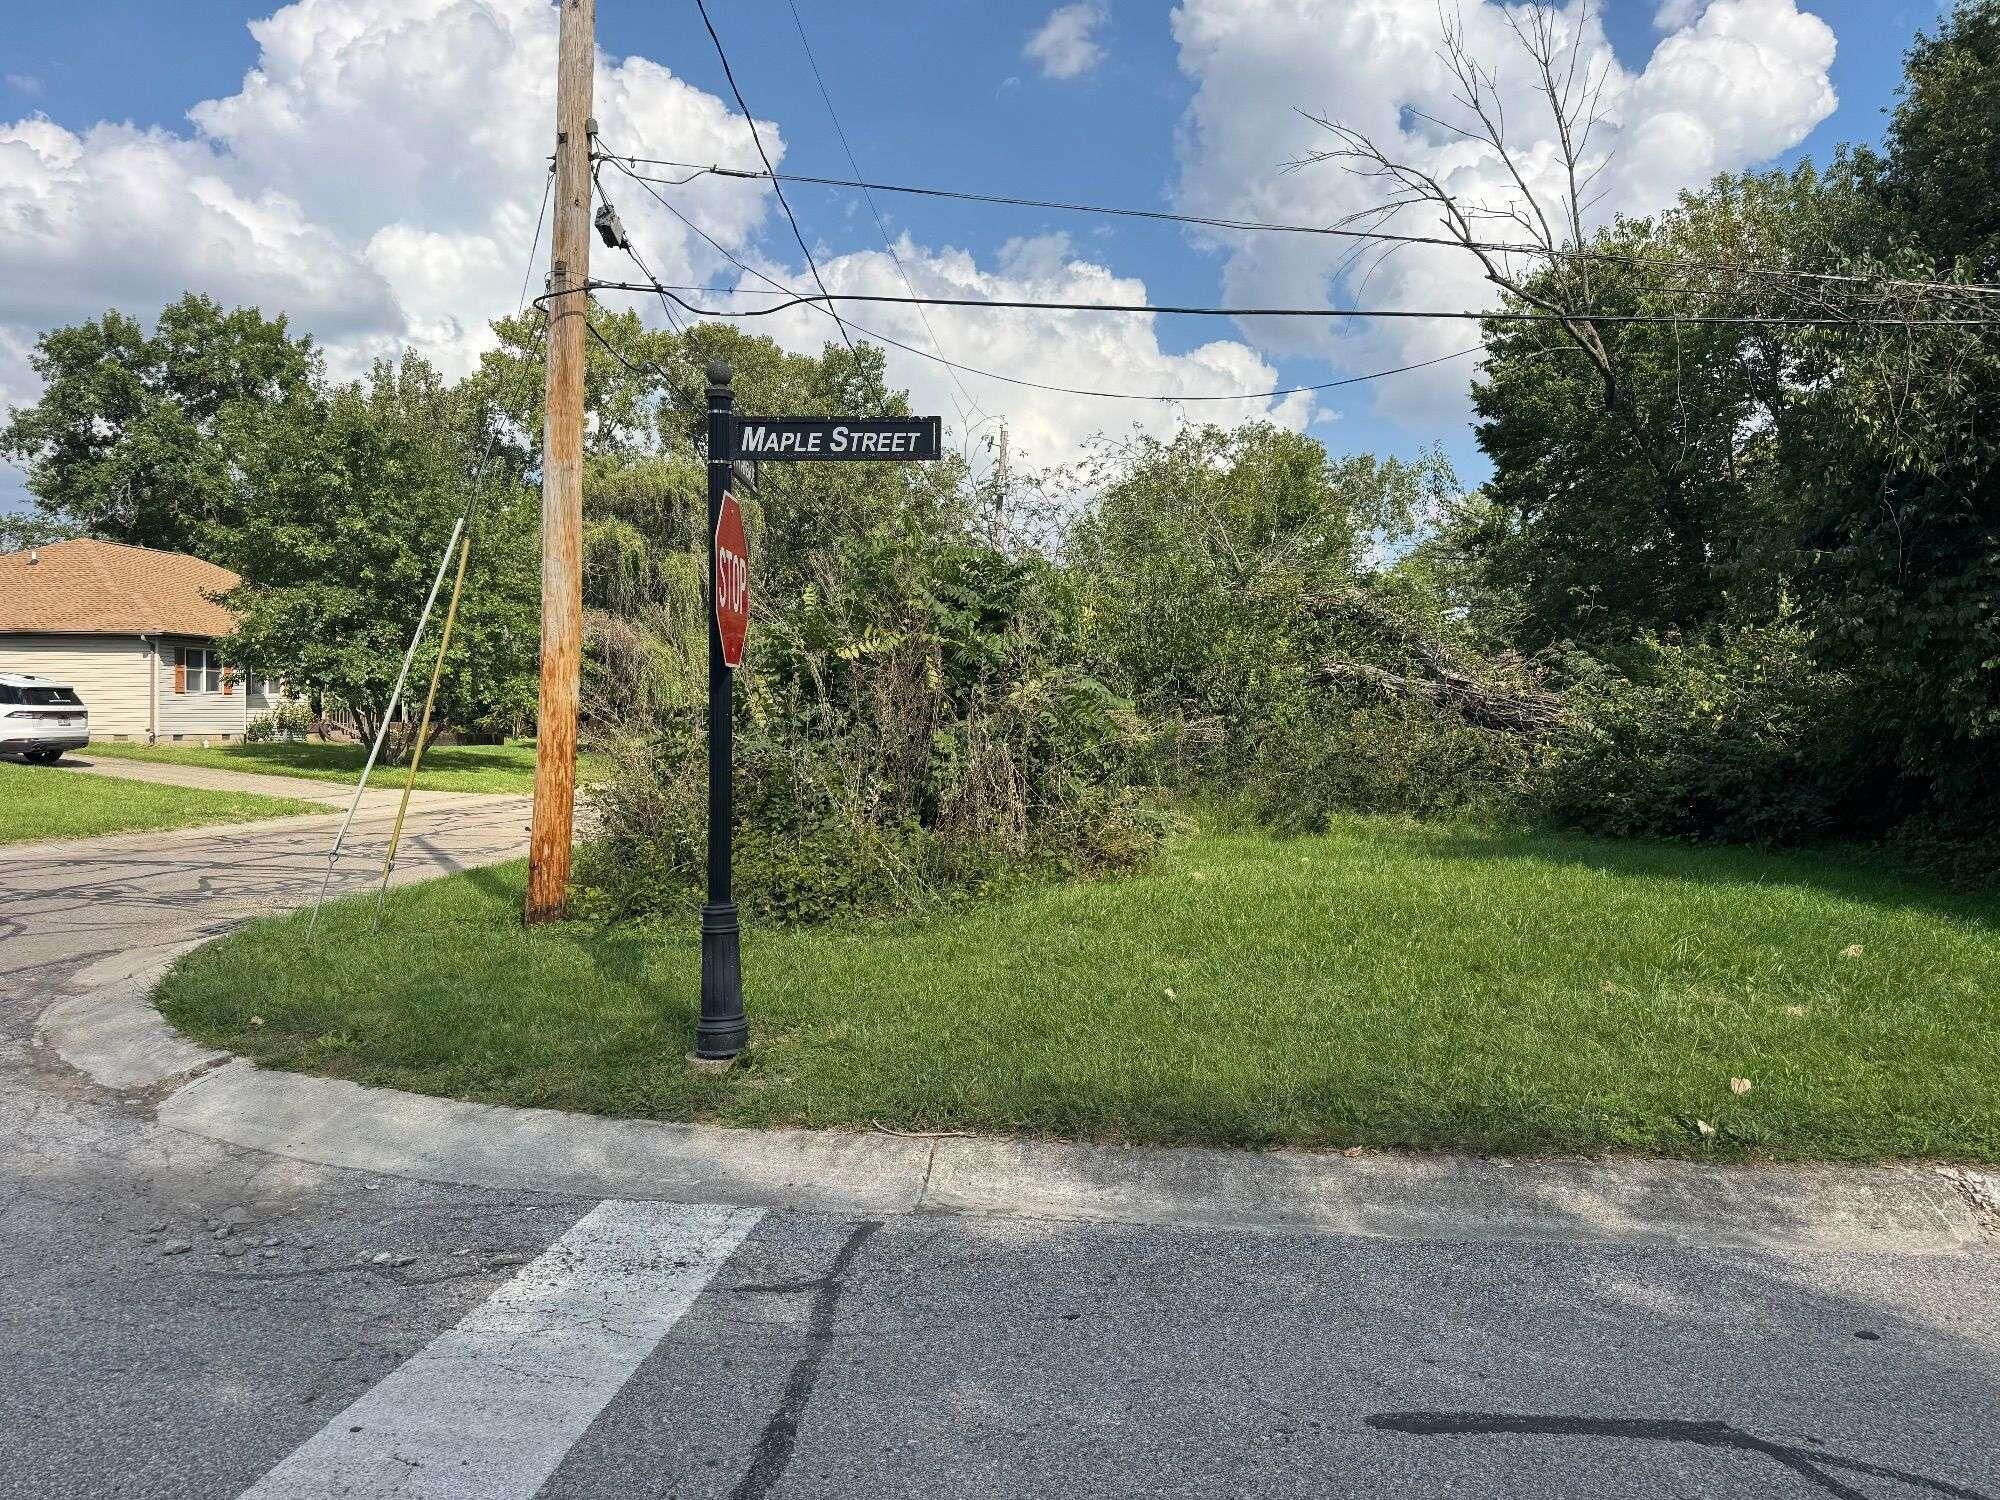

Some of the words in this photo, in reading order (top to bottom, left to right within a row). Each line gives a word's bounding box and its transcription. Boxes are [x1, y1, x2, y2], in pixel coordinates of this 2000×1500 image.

[741, 426, 823, 452] MAPLE
[829, 426, 921, 452] STREET
[719, 546, 747, 614] STOP
